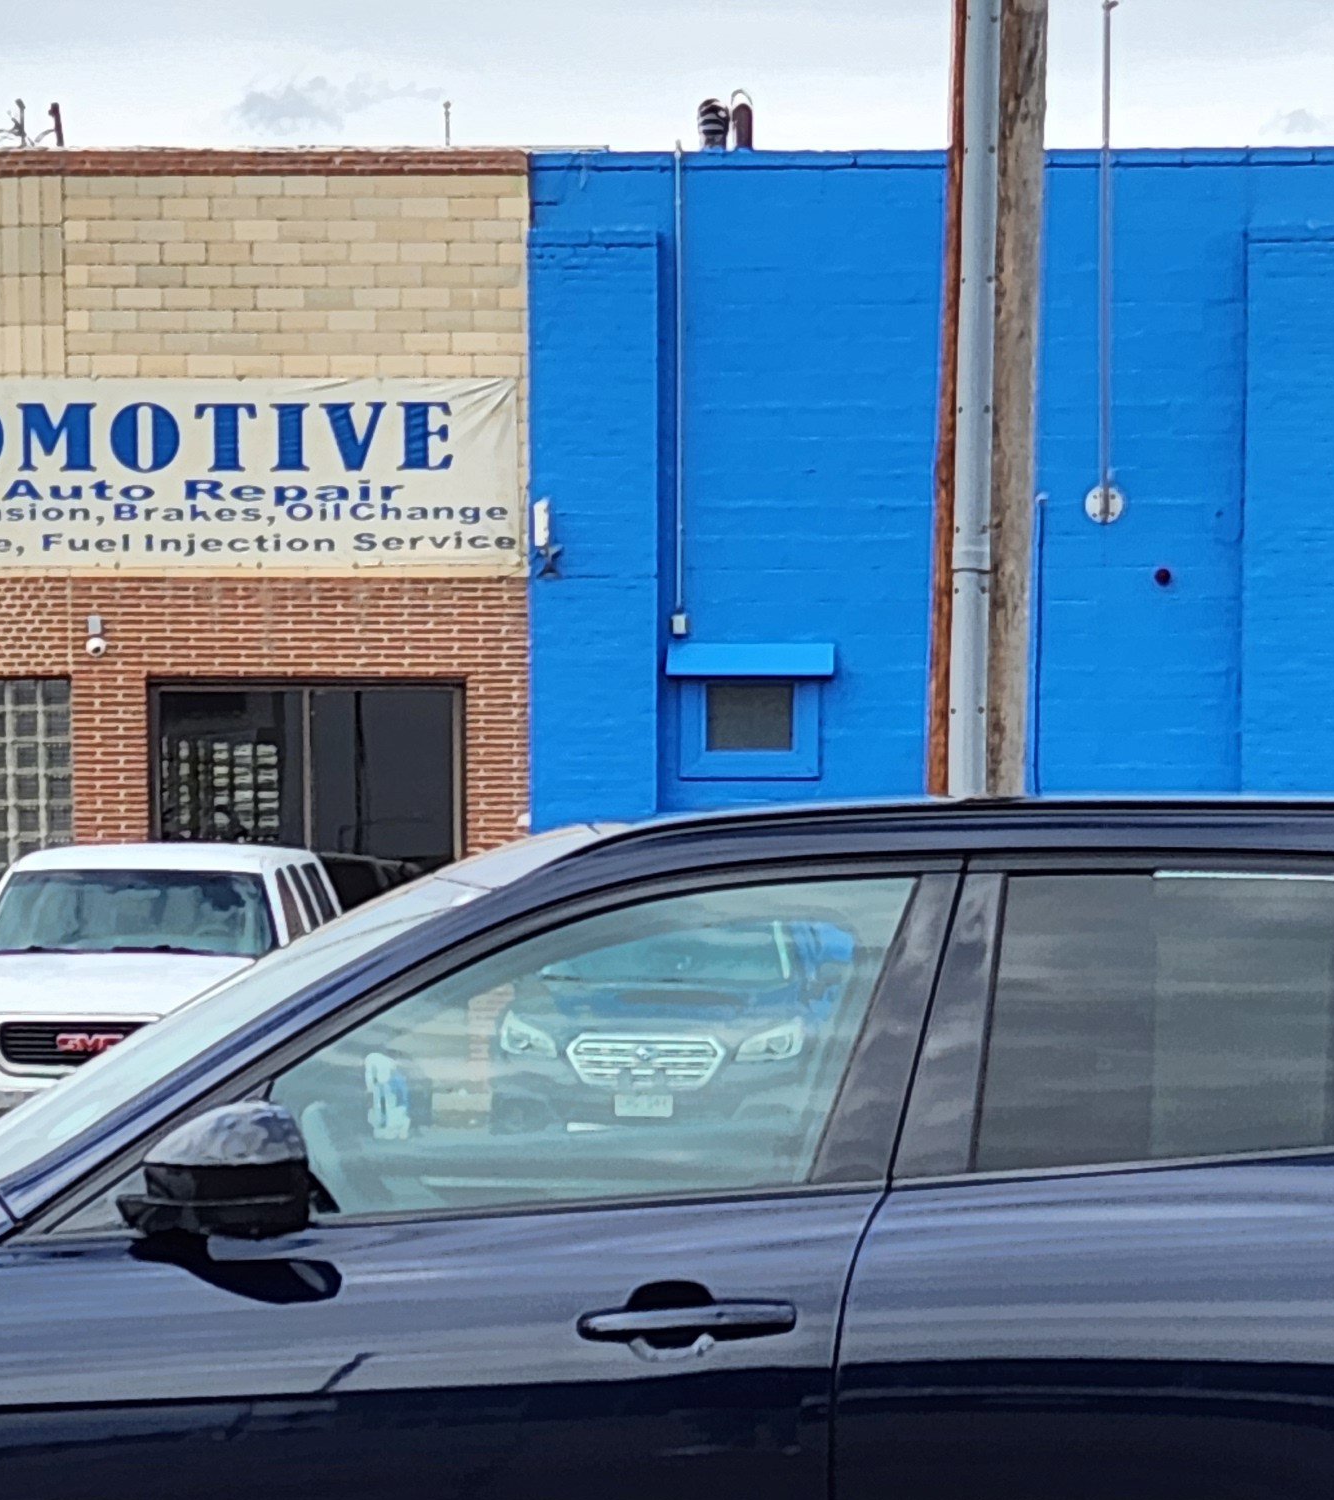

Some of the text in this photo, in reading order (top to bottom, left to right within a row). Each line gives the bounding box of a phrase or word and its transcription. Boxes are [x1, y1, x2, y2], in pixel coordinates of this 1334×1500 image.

[2, 479, 155, 501] Auto
[184, 479, 405, 507] Repair
[42, 533, 131, 551] Fuel
[145, 533, 335, 557] Injection
[353, 531, 516, 552] Service
